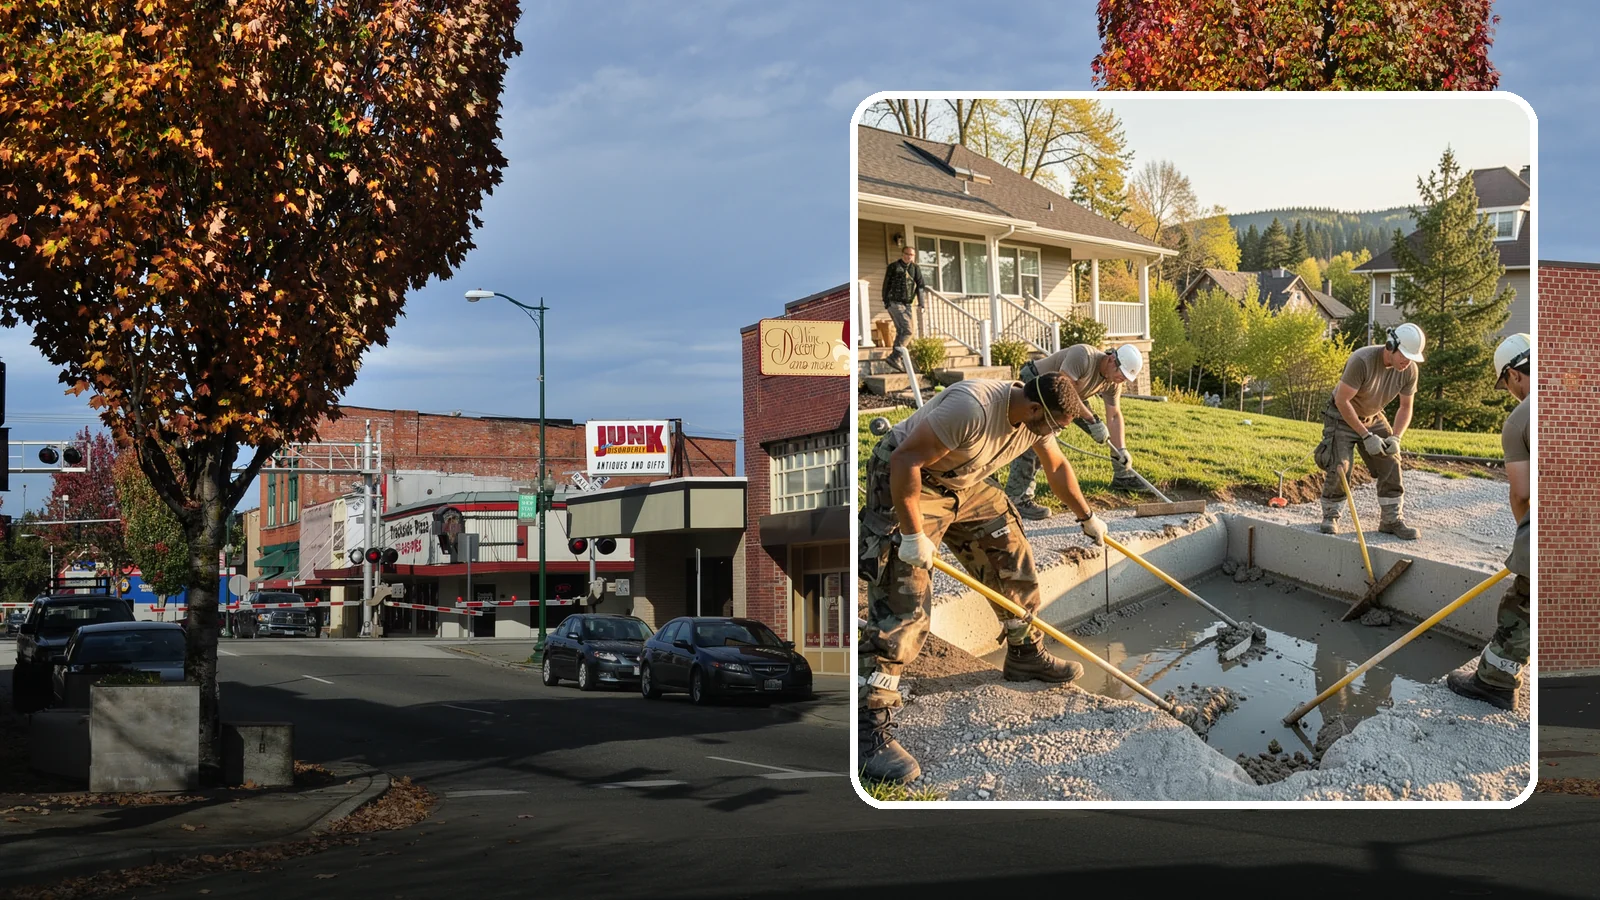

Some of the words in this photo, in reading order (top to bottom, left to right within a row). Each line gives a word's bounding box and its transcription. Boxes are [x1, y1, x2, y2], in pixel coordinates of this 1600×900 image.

[595, 425, 665, 457] JUNK
[607, 446, 646, 454] DISORDERLY
[596, 460, 629, 470] ANTIQUES
[631, 460, 644, 470] AND
[647, 460, 666, 470] GIFTS
[390, 521, 413, 540] Trackside
[414, 519, 429, 535] Pizza
